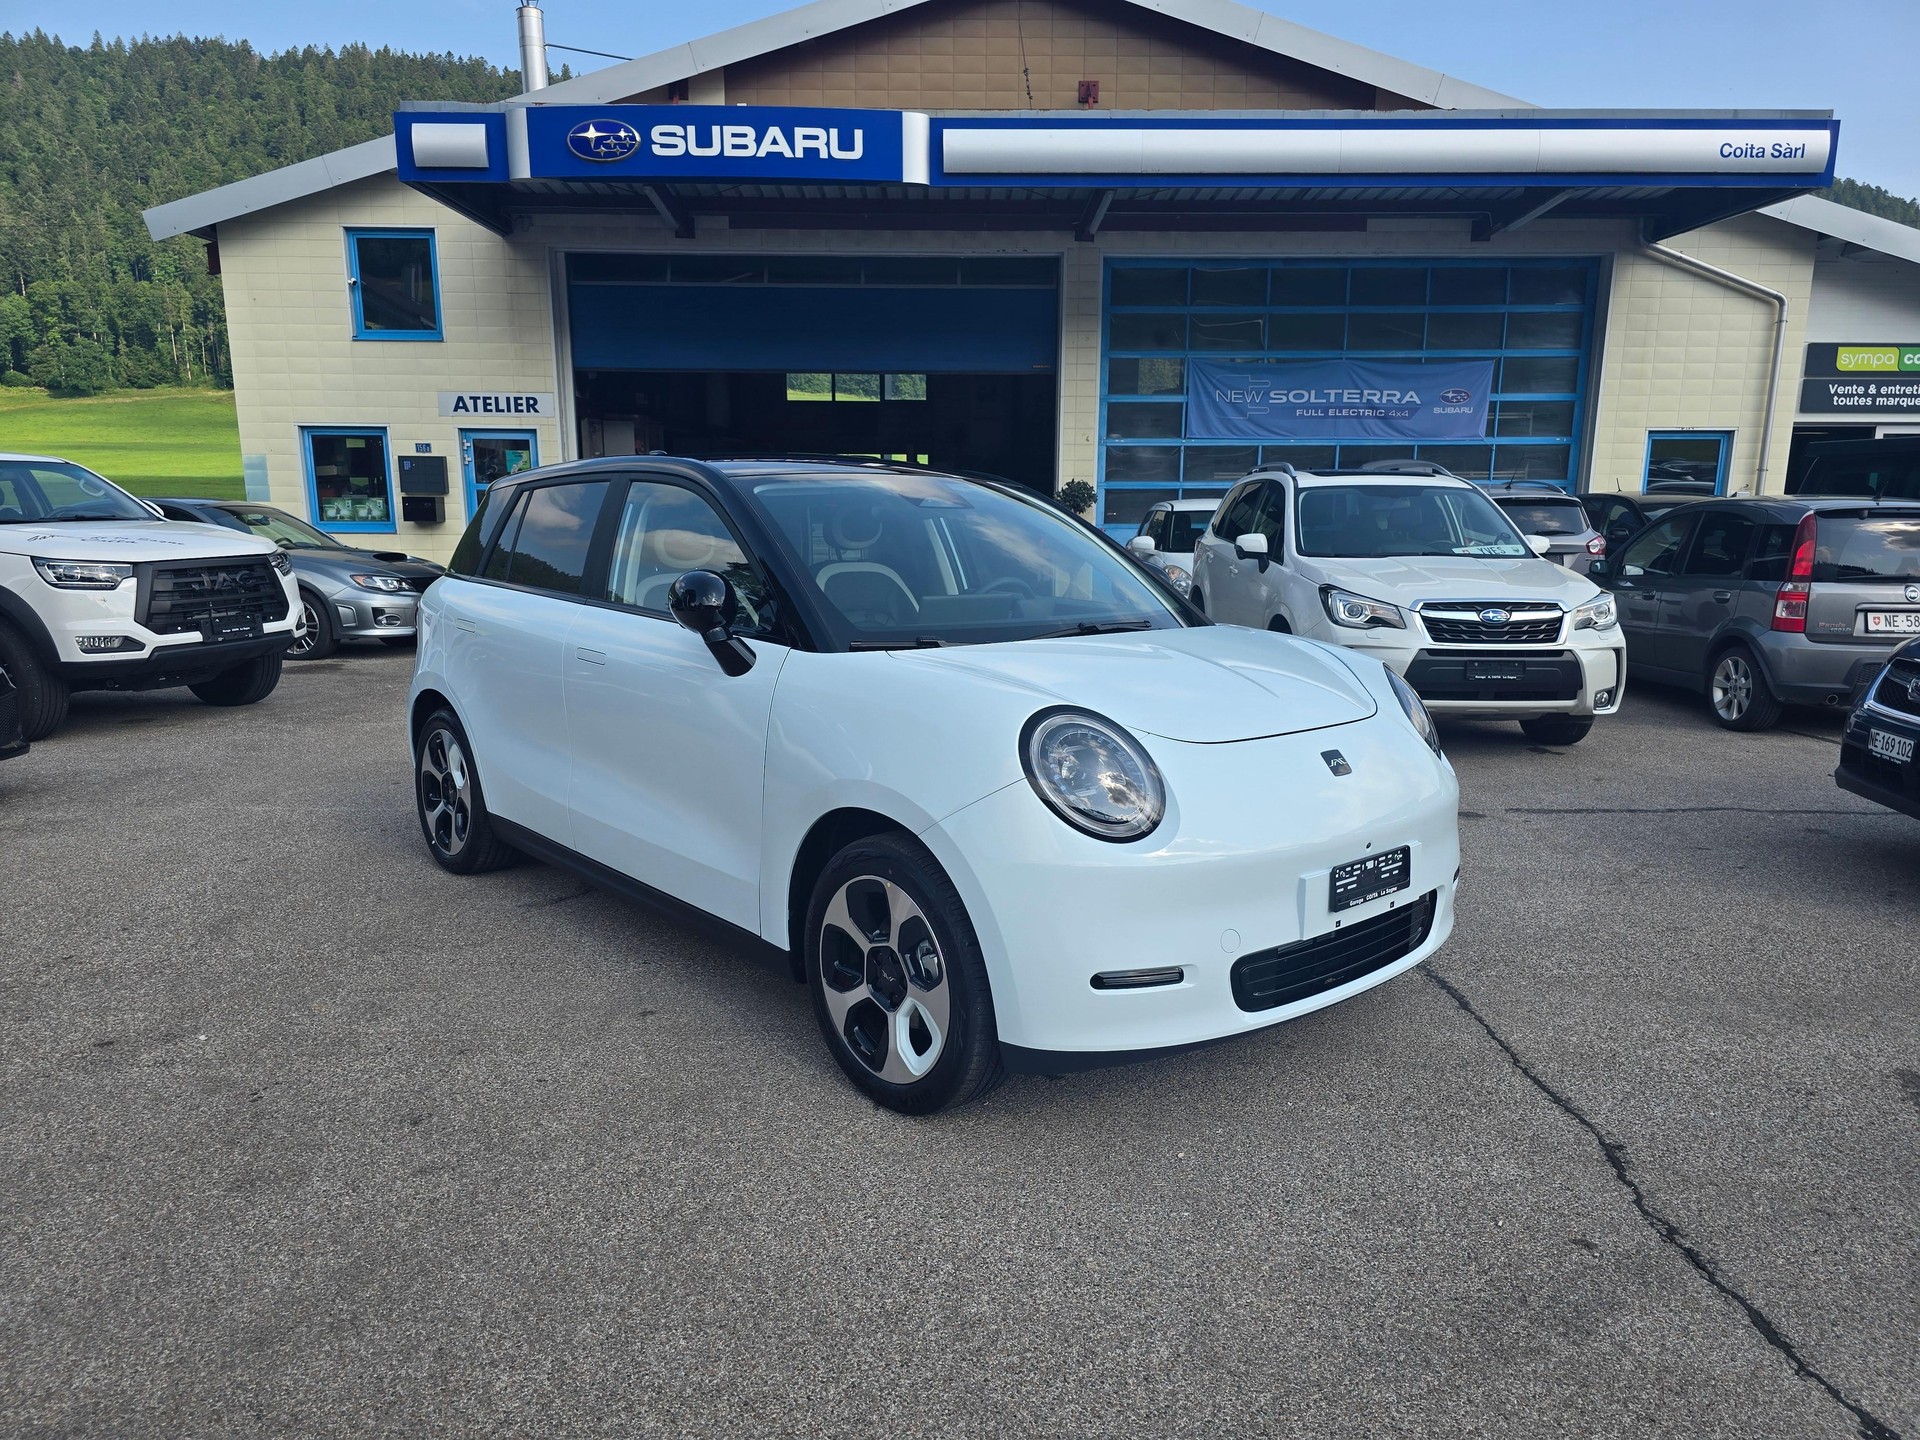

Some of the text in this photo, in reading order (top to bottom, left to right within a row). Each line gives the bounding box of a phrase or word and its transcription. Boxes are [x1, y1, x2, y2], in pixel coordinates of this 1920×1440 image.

[651, 125, 863, 160] SUBARU
[1719, 142, 1806, 159] Coita Sàrl
[1841, 353, 1895, 368] sympa
[1215, 389, 1422, 405] NEW SOLTERRA
[1829, 384, 1865, 395] Vente
[1868, 384, 1877, 395] &
[453, 396, 540, 414] ATELIER
[1833, 395, 1872, 406] toutes
[1296, 409, 1325, 417] FULL
[1328, 408, 1385, 417] ELECTRIC
[1433, 406, 1474, 414] SUBARU
